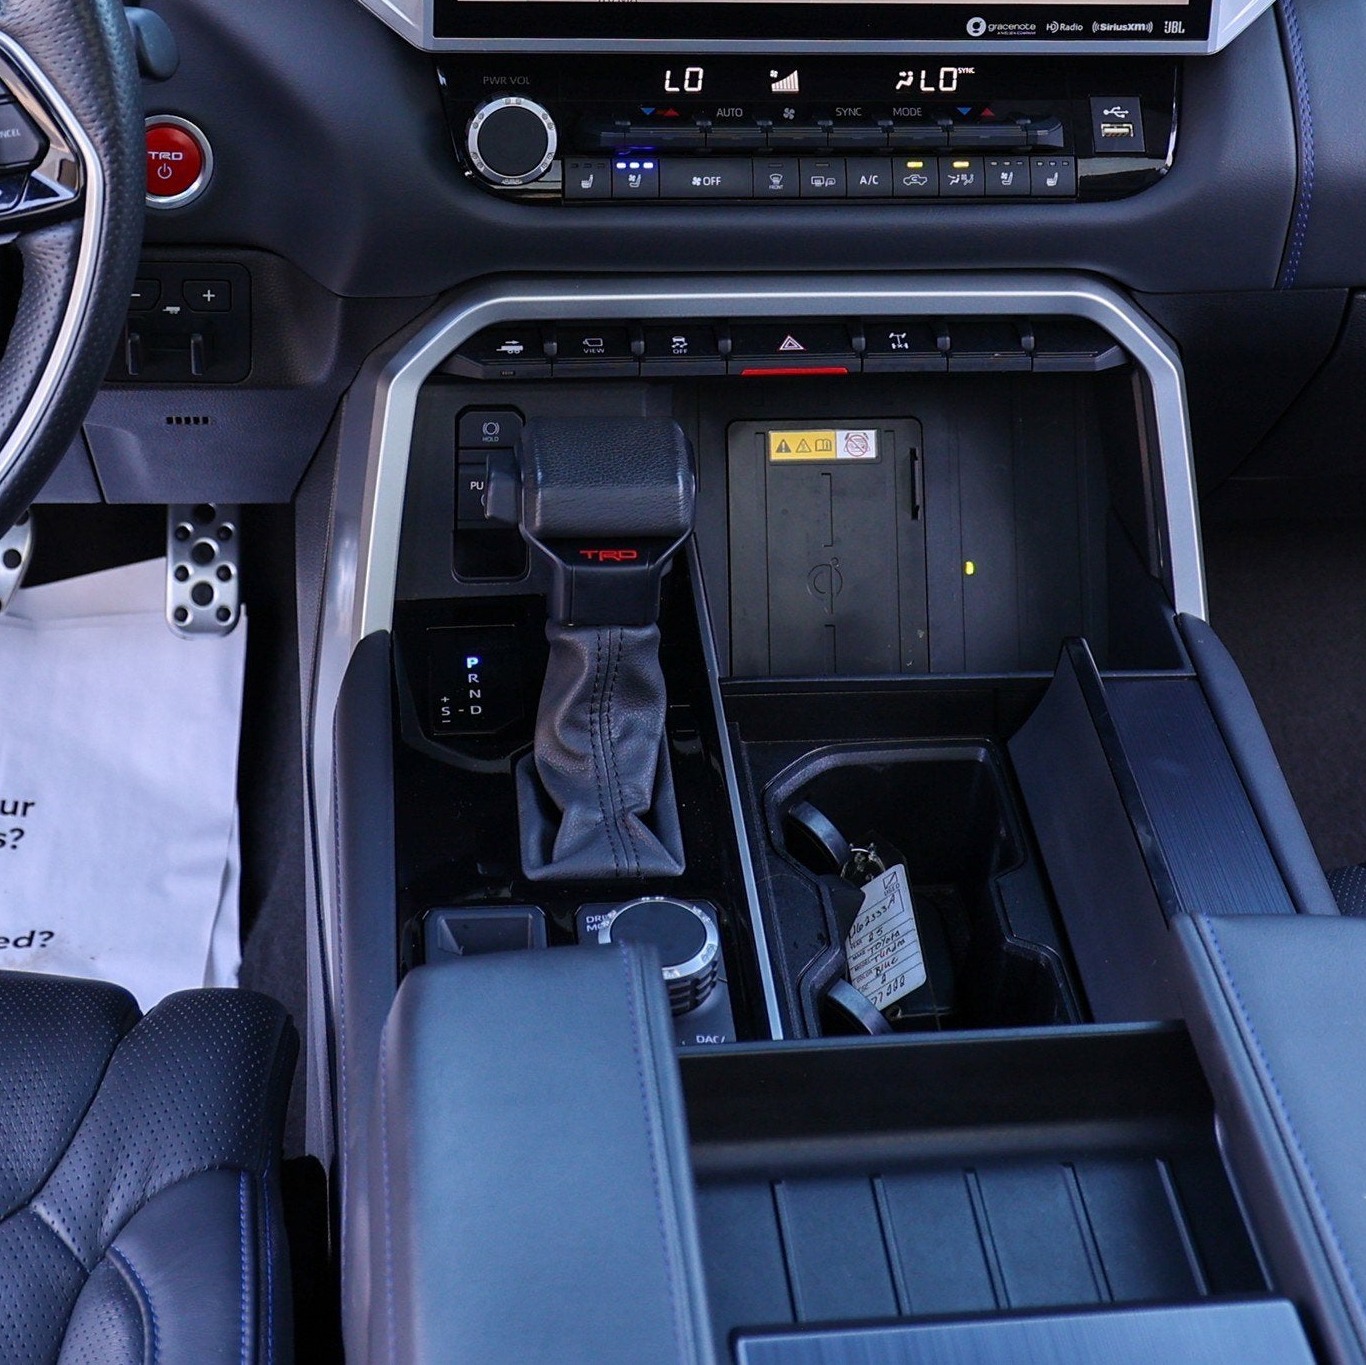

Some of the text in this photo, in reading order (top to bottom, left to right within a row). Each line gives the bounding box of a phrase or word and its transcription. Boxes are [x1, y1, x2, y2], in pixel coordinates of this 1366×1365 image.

[988, 22, 1036, 32] gracenote
[1060, 23, 1083, 31] Radio
[1164, 21, 1185, 33] JBL
[483, 76, 530, 85] PWR VOL
[717, 107, 743, 118] AUTO
[836, 107, 862, 117] SYNC
[893, 107, 922, 117] MODE
[147, 151, 184, 161] TRD
[703, 176, 721, 186] OFF
[860, 175, 879, 185] A/C
[580, 550, 637, 561] TRD
[466, 657, 479, 668] P
[468, 674, 479, 683] R
[469, 690, 481, 699] N
[441, 706, 482, 716] S D
